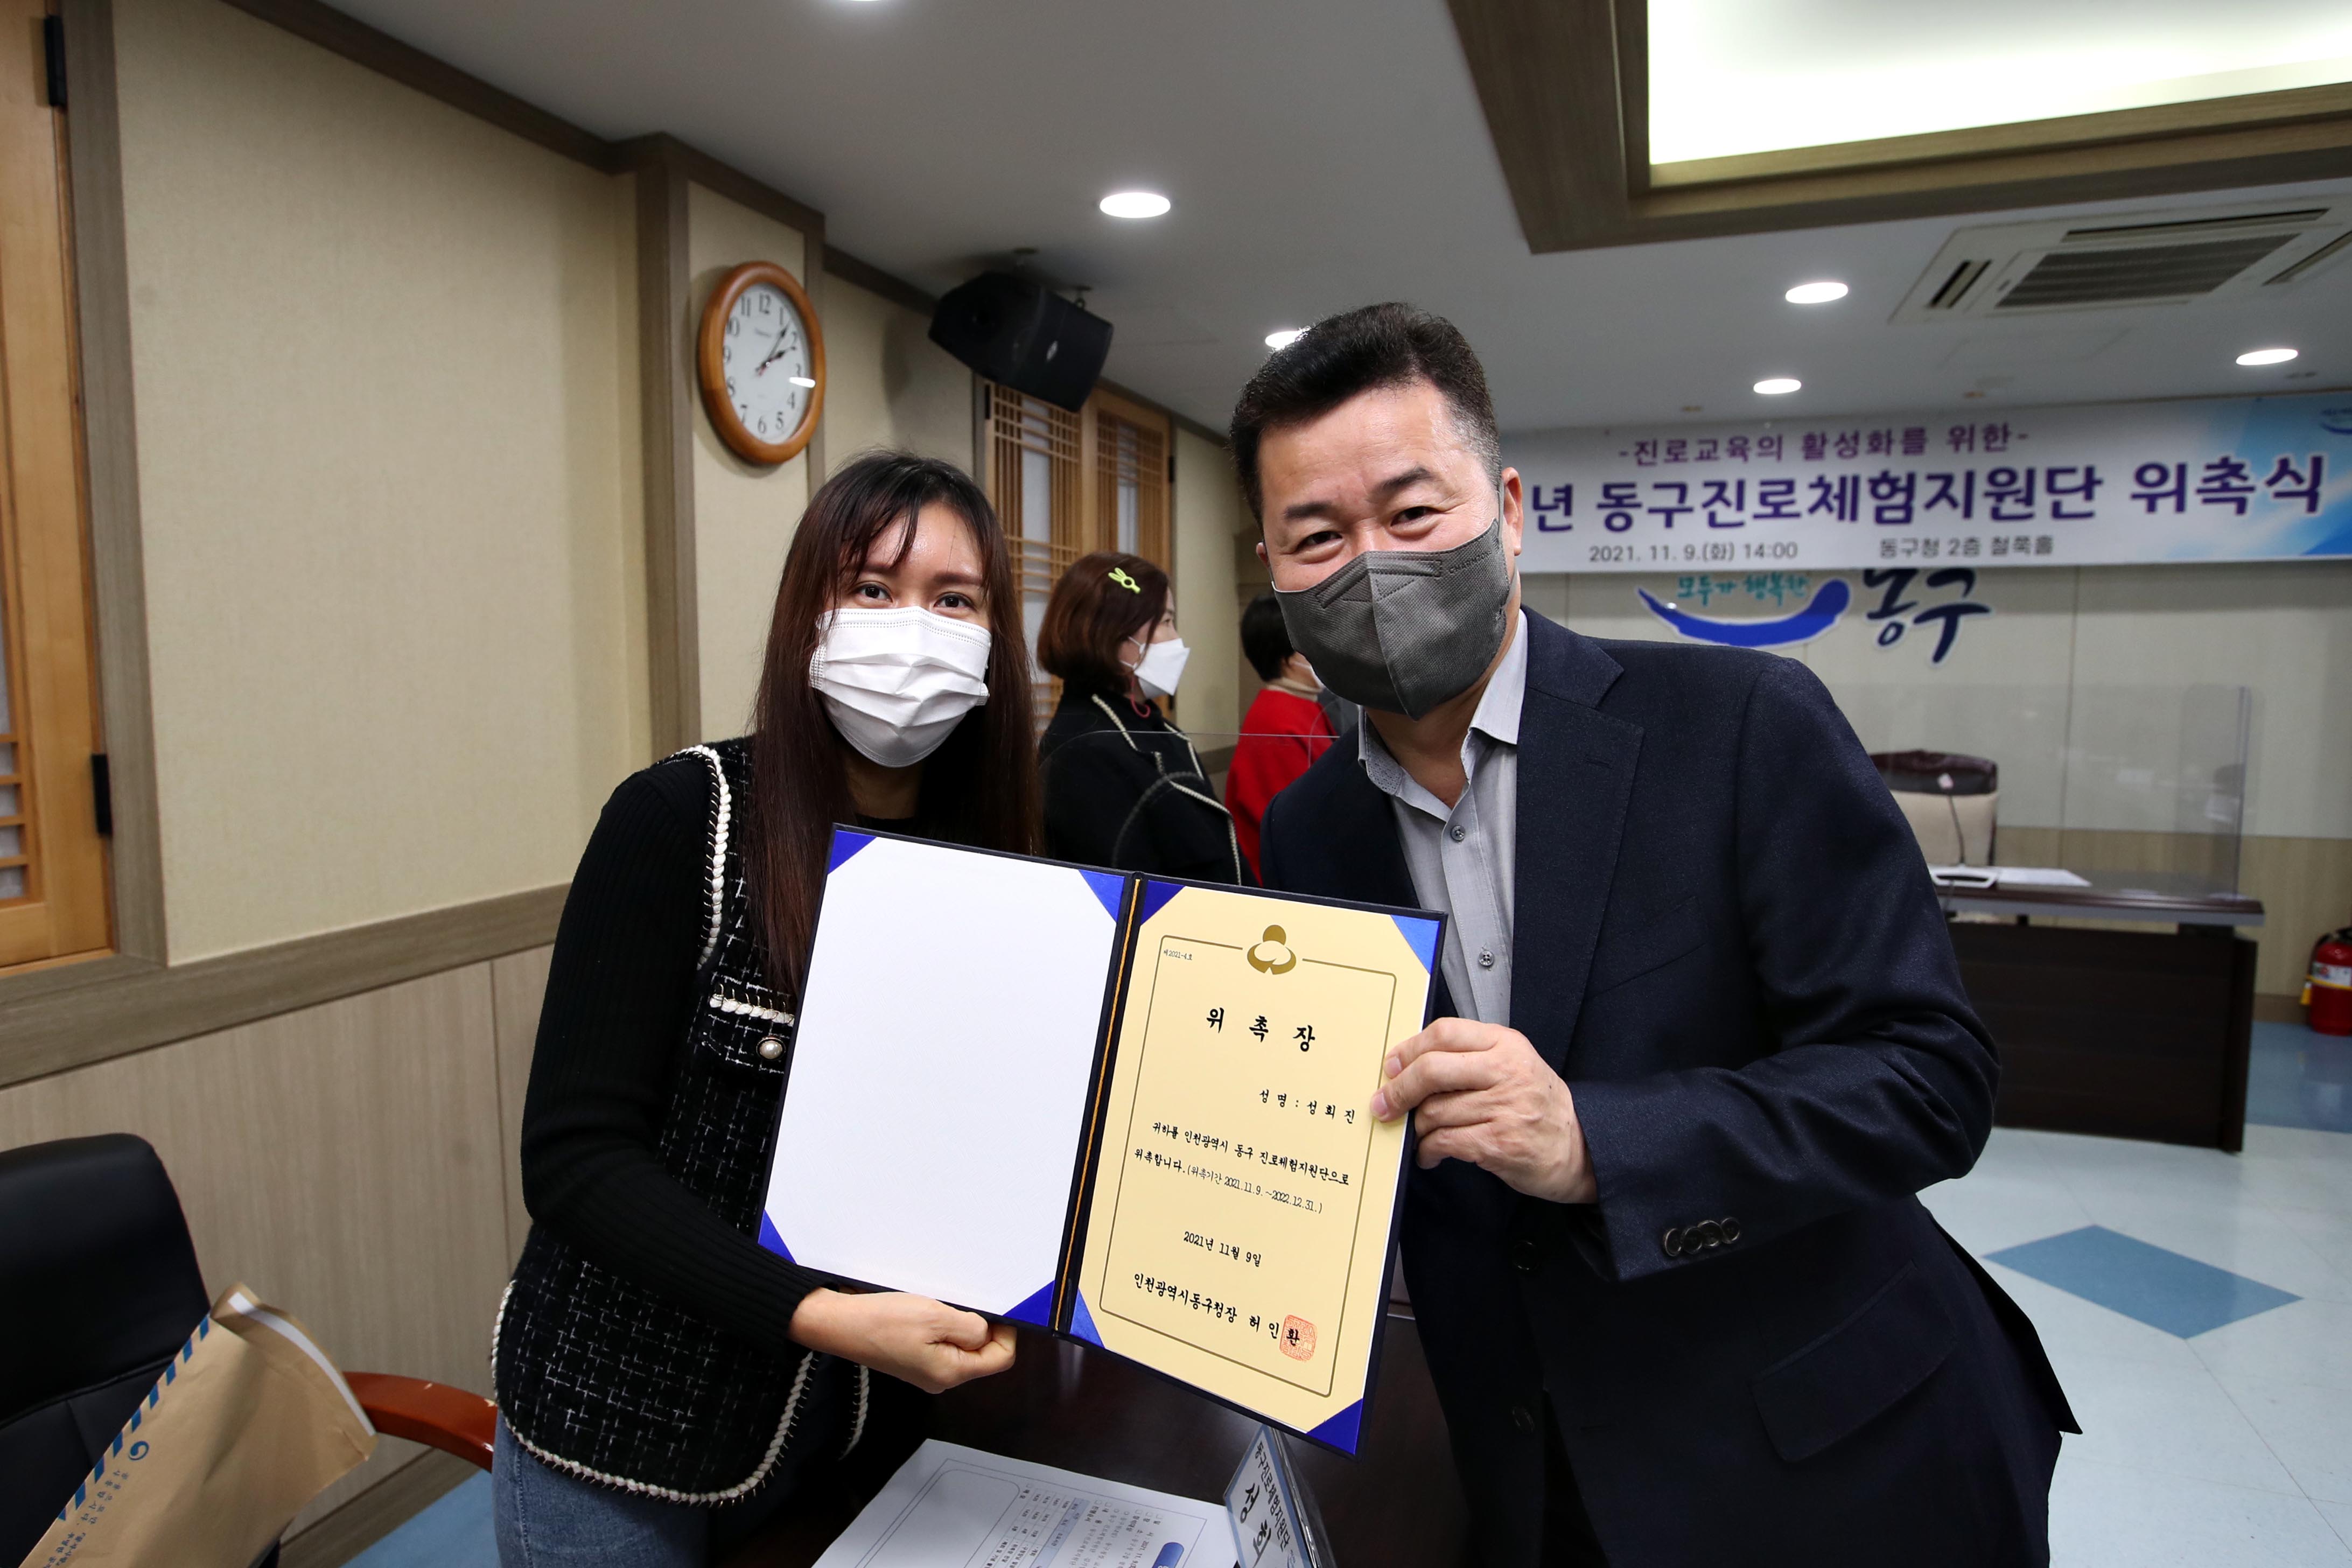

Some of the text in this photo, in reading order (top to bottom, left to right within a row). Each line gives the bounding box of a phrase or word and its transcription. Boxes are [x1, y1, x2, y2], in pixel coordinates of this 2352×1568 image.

[759, 292, 772, 314] 12
[1801, 428, 1928, 460] 활성화를
[1531, 452, 2328, 533] 년 동구진로체험지원단 위촉식
[1745, 541, 1798, 559] 14:00
[1879, 534, 2055, 559] 동구청 2층 철쭉홀
[1676, 574, 1810, 608] 모두가 행복한
[1861, 568, 1991, 664] 동구
[1152, 1122, 1349, 1185] 귀하를 인천광역시 동구 진로체험지원단으로
[1184, 1231, 1262, 1268] 2021년 11월 9일
[1134, 1273, 1237, 1324] 인천광역시동구청장
[1255, 1441, 1290, 1552] 동구진로체험지원단
